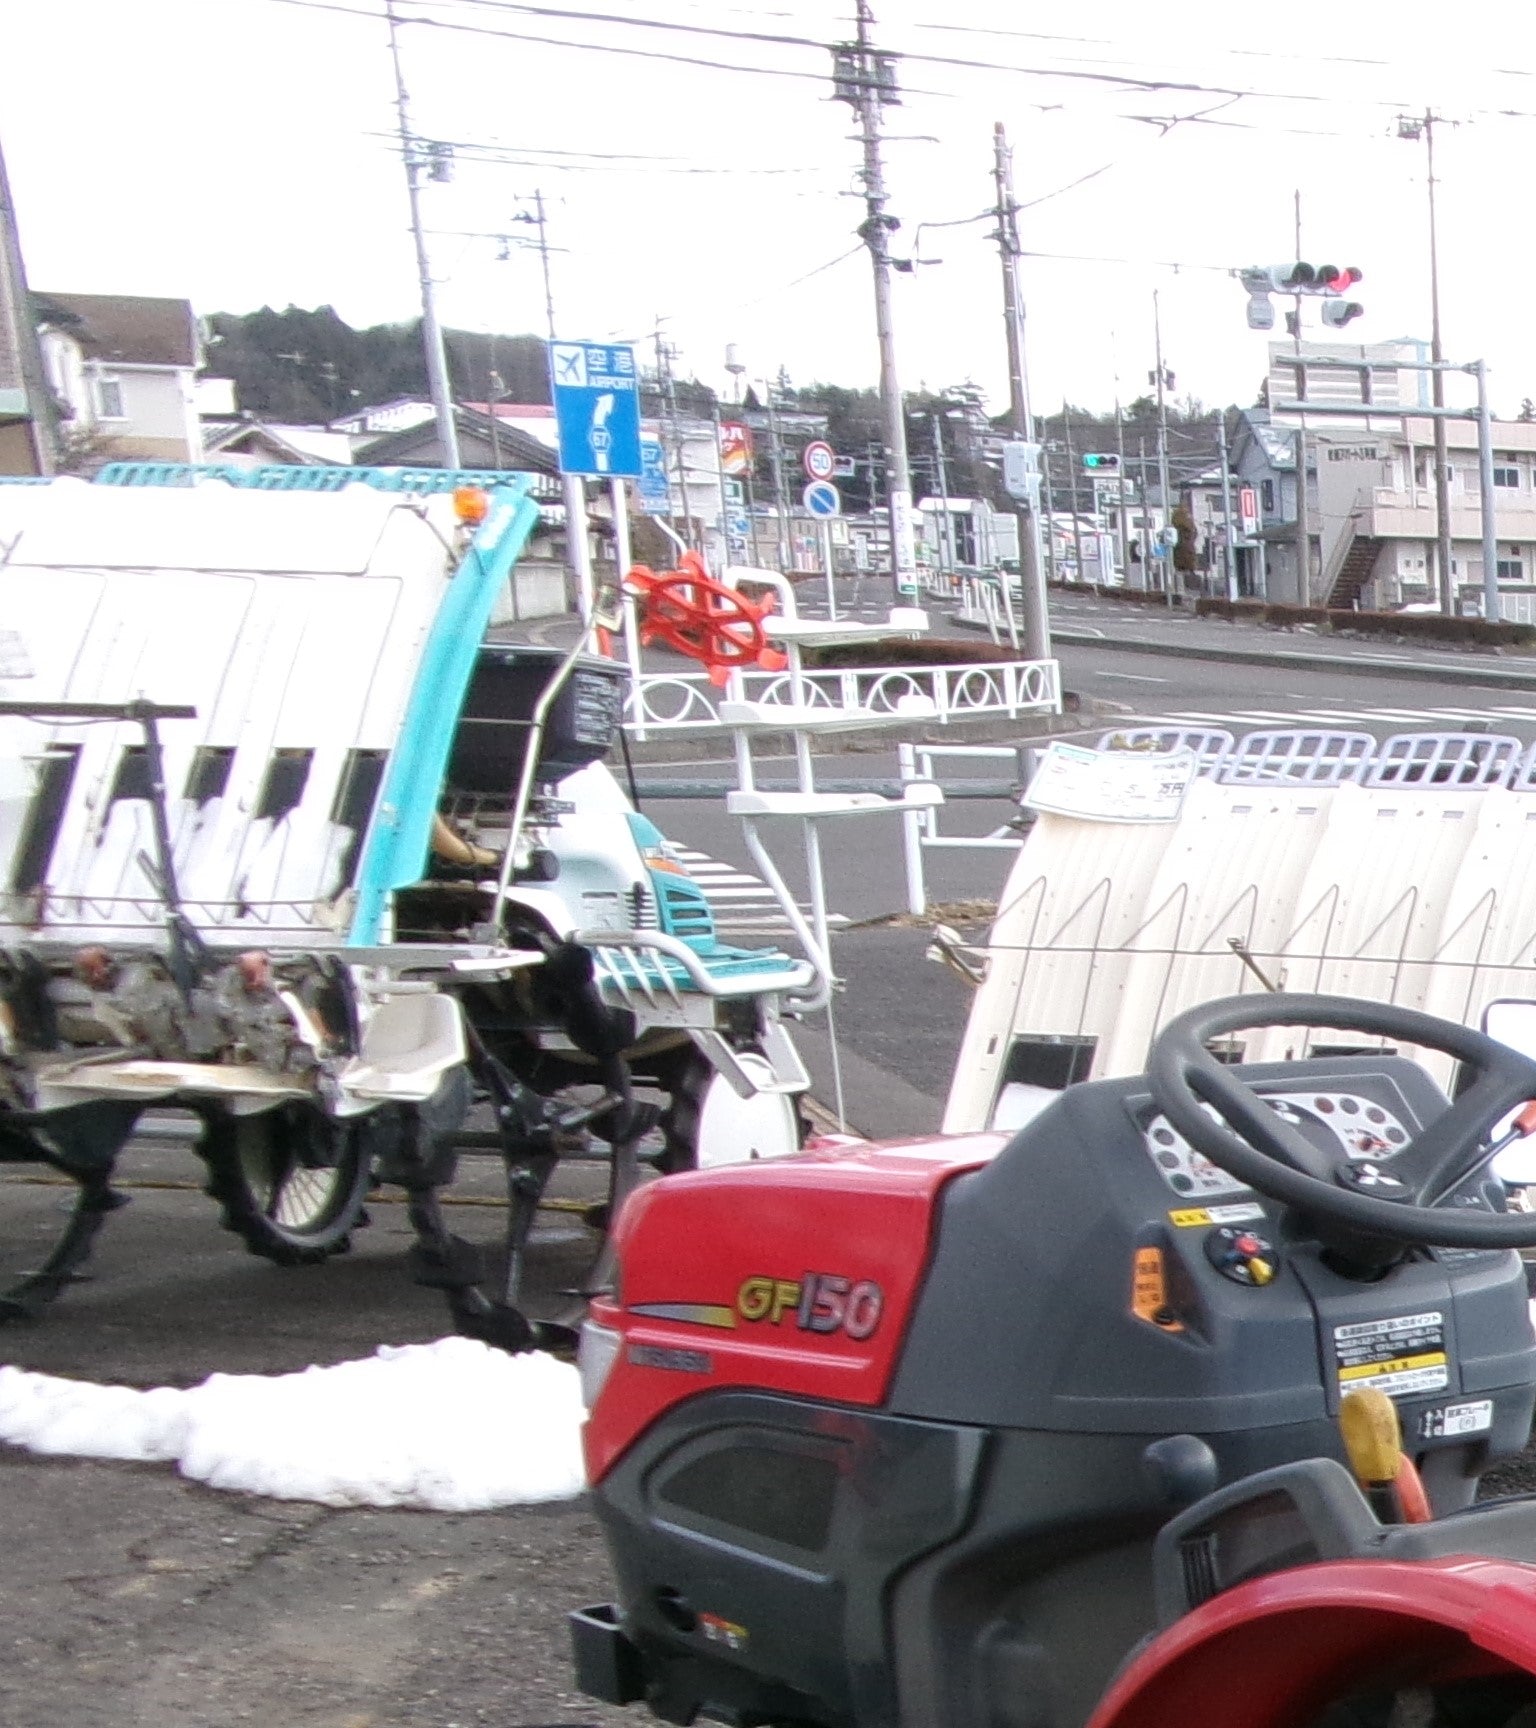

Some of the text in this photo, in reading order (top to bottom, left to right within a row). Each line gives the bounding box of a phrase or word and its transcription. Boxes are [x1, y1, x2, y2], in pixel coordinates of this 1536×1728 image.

[587, 348, 635, 374] 空港
[588, 375, 636, 391] AIRPORT
[812, 453, 829, 470] 50
[736, 1271, 885, 1341] GF150
